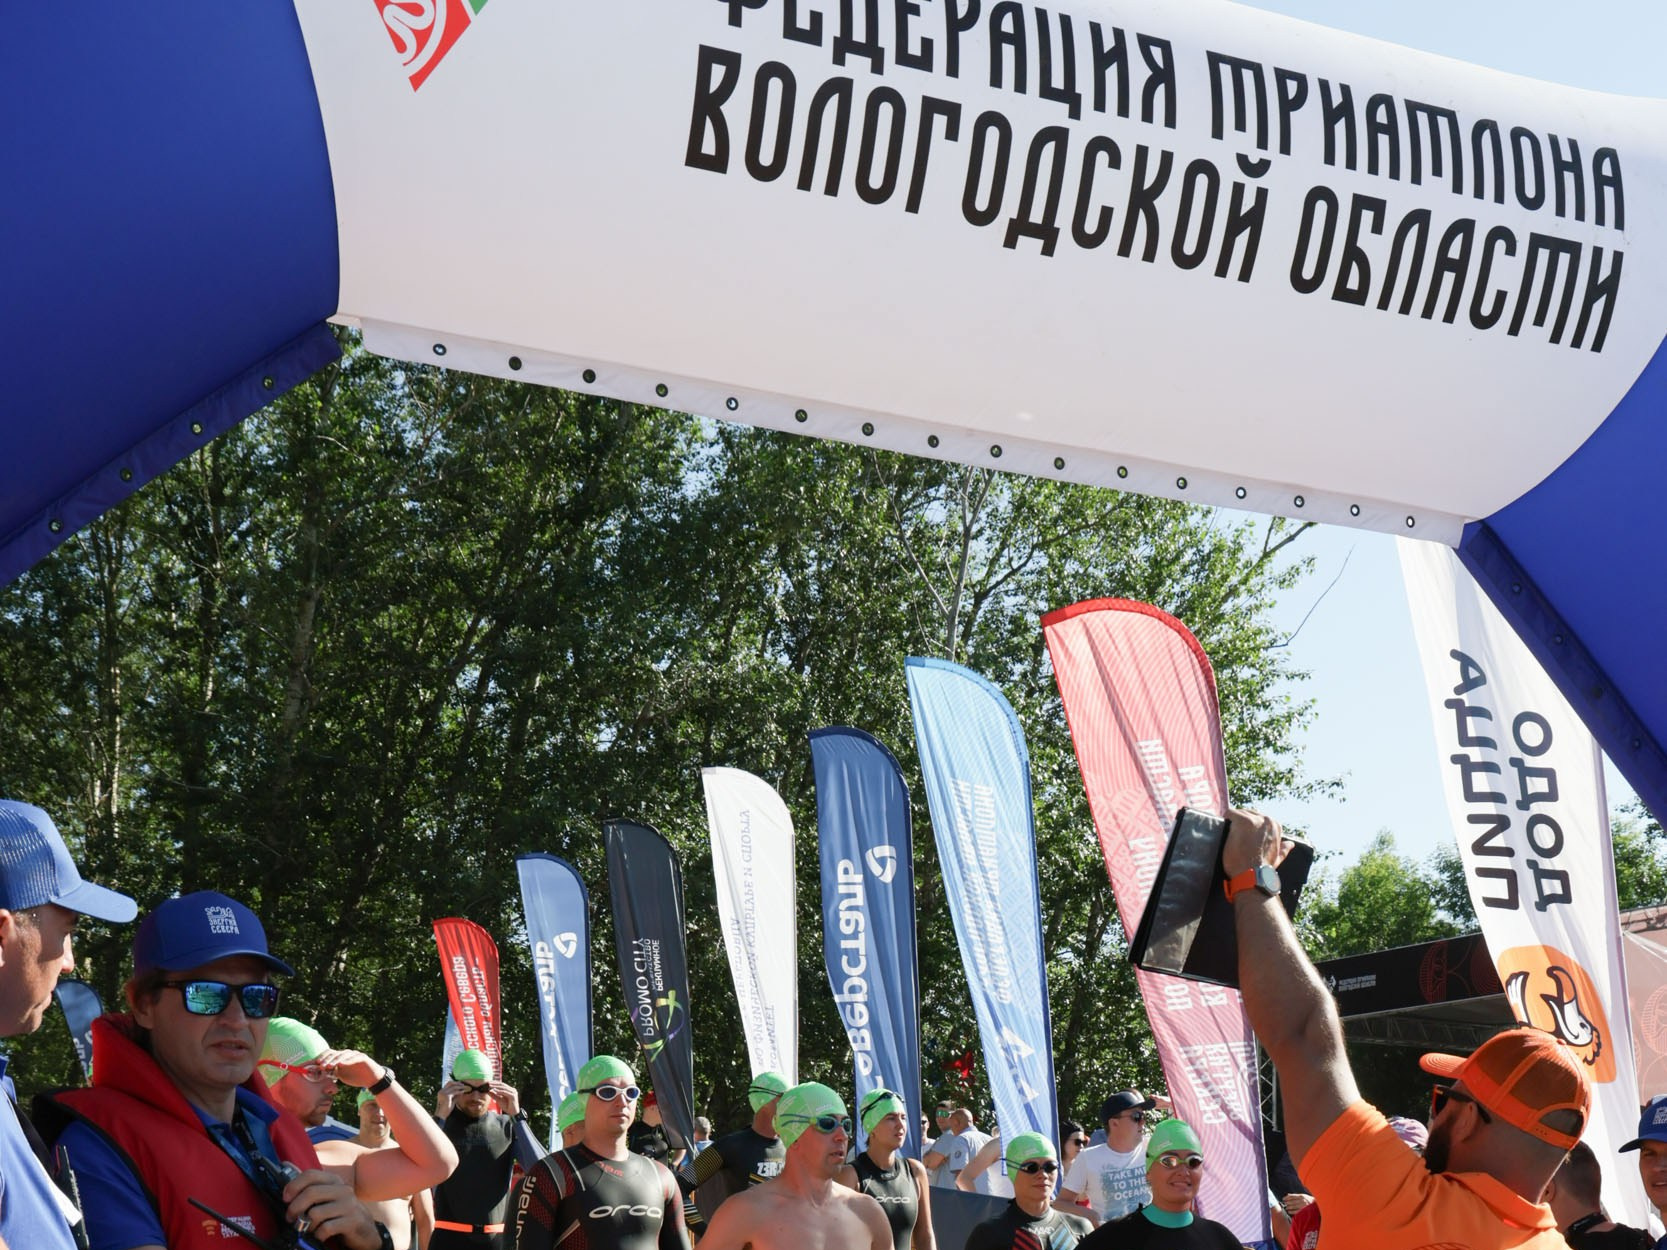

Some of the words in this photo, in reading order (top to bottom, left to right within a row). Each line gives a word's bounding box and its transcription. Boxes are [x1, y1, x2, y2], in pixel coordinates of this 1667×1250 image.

[717, 0, 1177, 129] ДЕРАЦИЯ
[1206, 50, 1625, 231] ТРИАТЛОНА
[684, 43, 1271, 283] ВОЛОГОДСКОЙ
[1289, 185, 1624, 353] ОБЛАСТИ
[1108, 1170, 1132, 1181] TAKE
[1113, 1181, 1126, 1190] TO
[1128, 1177, 1147, 1188] THE
[589, 1204, 663, 1218] orca
